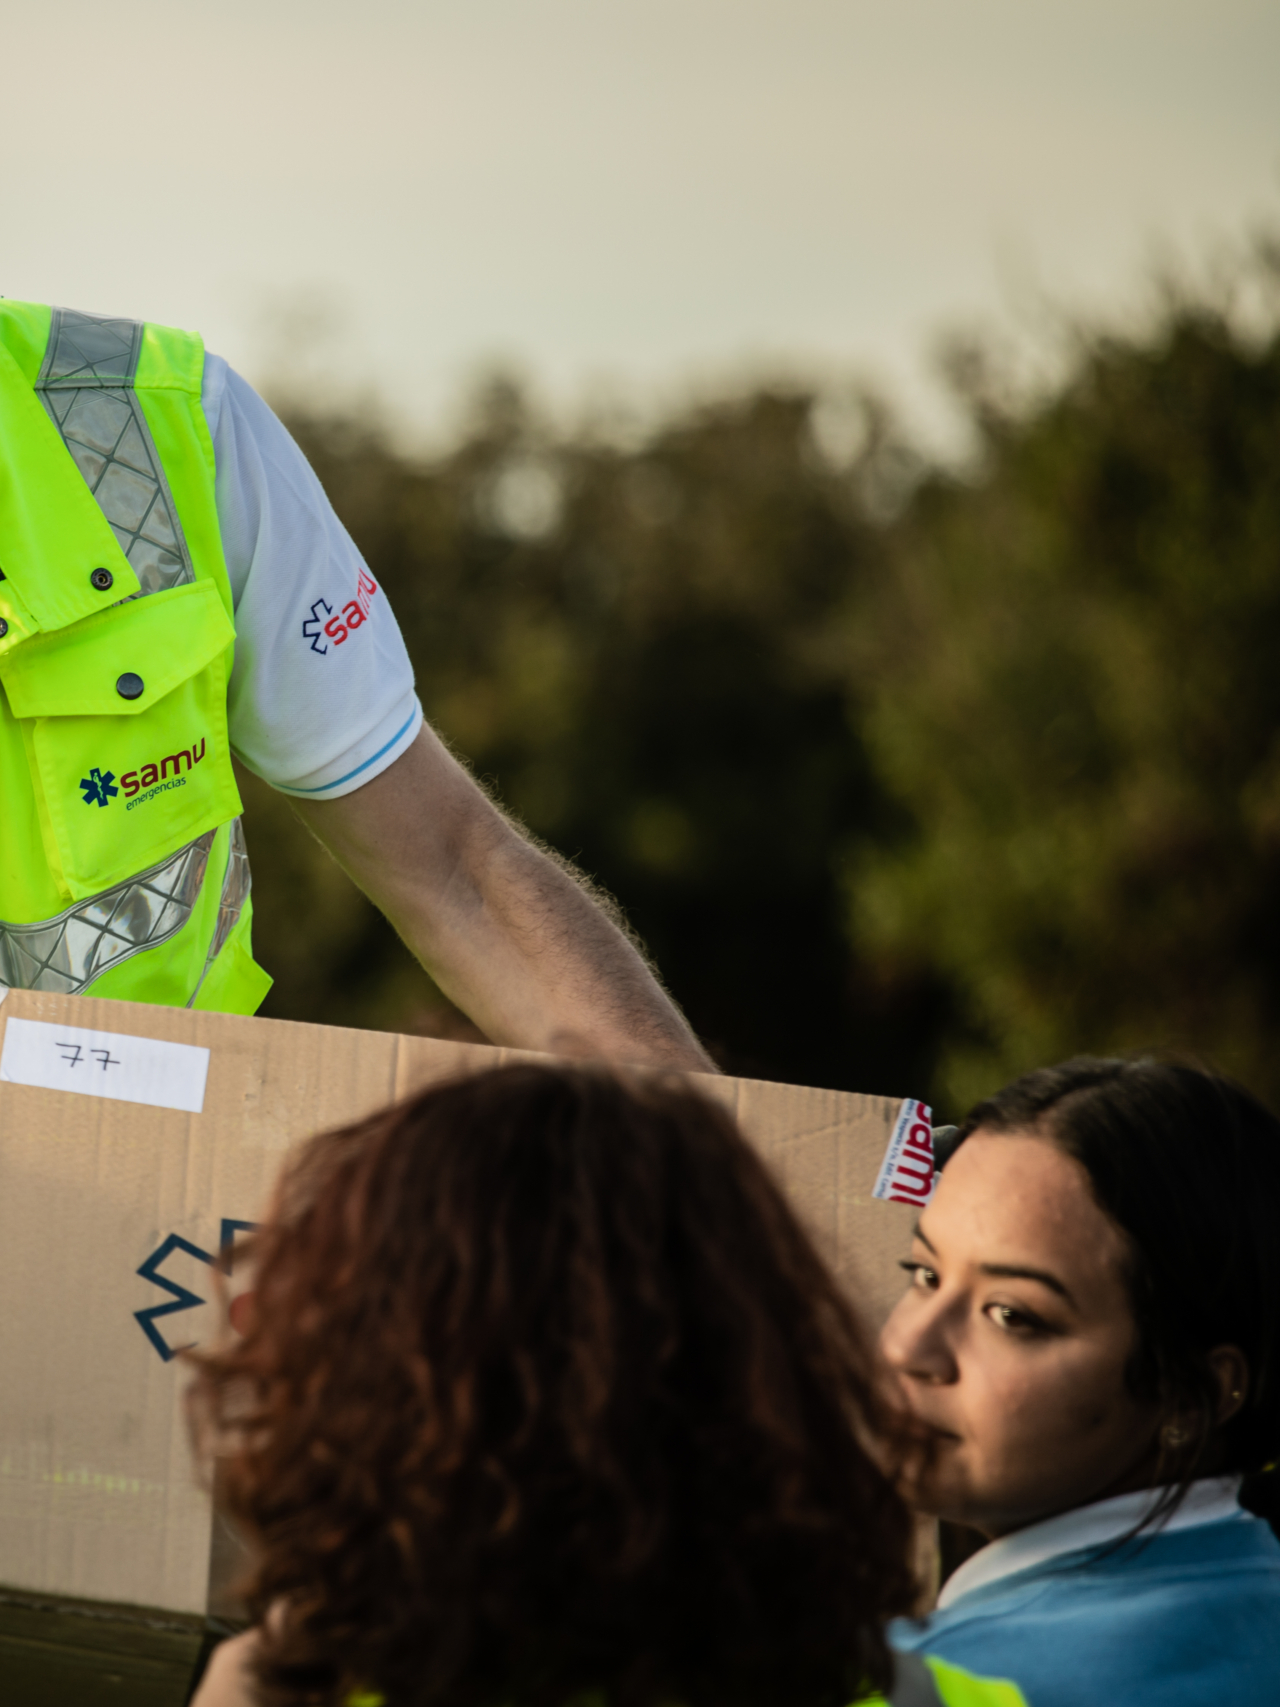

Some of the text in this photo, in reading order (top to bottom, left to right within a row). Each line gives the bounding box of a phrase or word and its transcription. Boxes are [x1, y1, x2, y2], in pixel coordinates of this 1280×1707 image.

[324, 567, 377, 646] samu
[120, 737, 205, 798] samu
[126, 776, 187, 811] emergencias
[55, 1042, 121, 1071] 77
